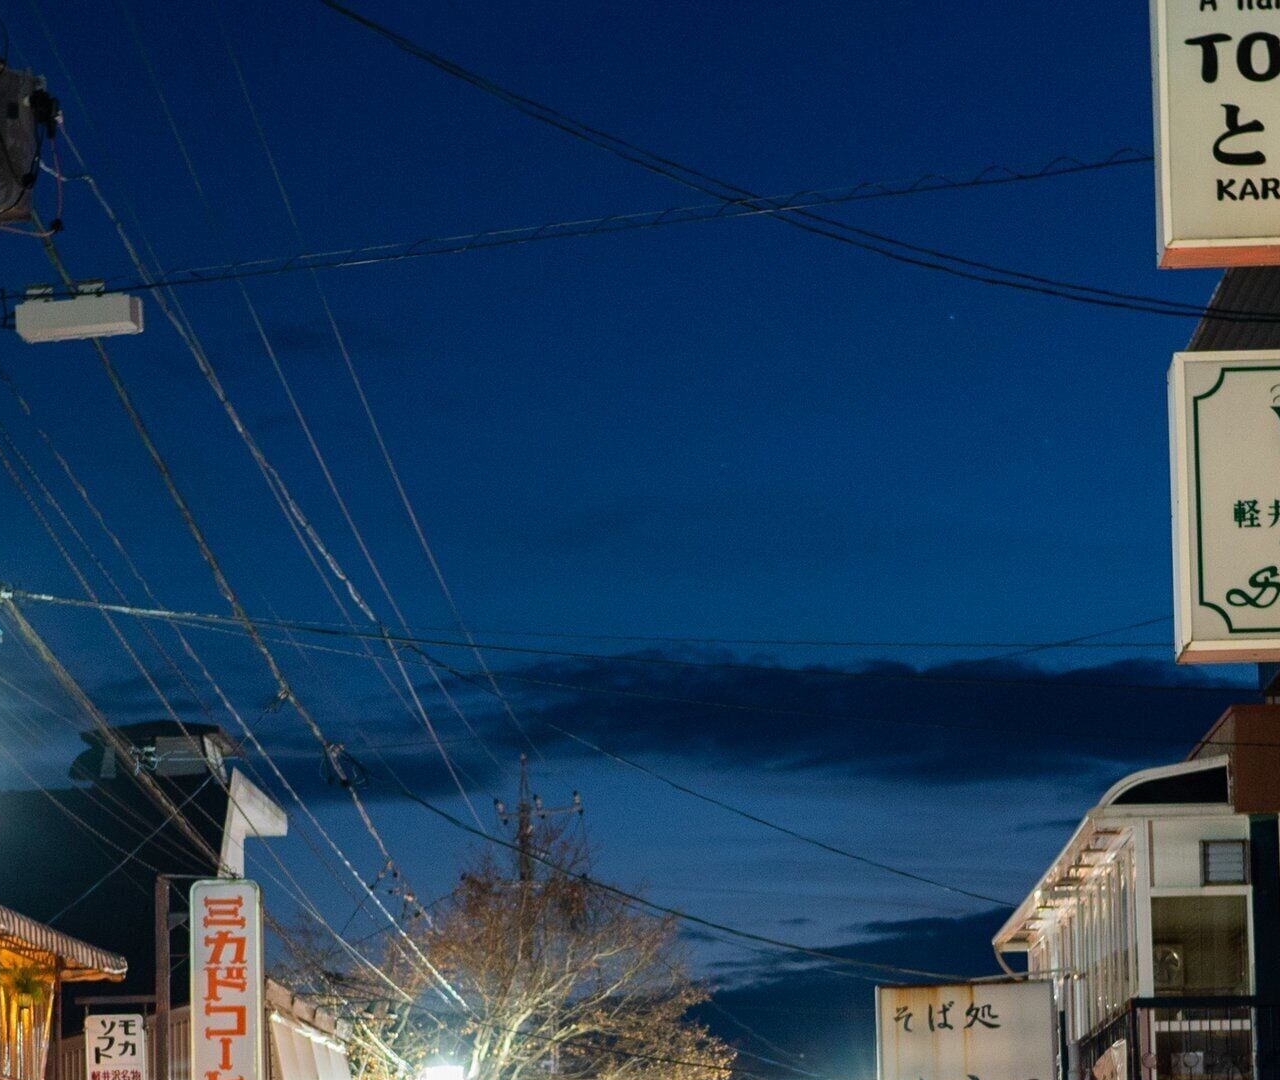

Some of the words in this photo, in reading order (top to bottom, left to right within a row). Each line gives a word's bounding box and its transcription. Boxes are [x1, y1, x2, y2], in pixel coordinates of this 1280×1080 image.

[893, 1000, 1002, 1033] そば処
[94, 1018, 114, 1066] ソフト
[118, 1018, 137, 1057] モカ
